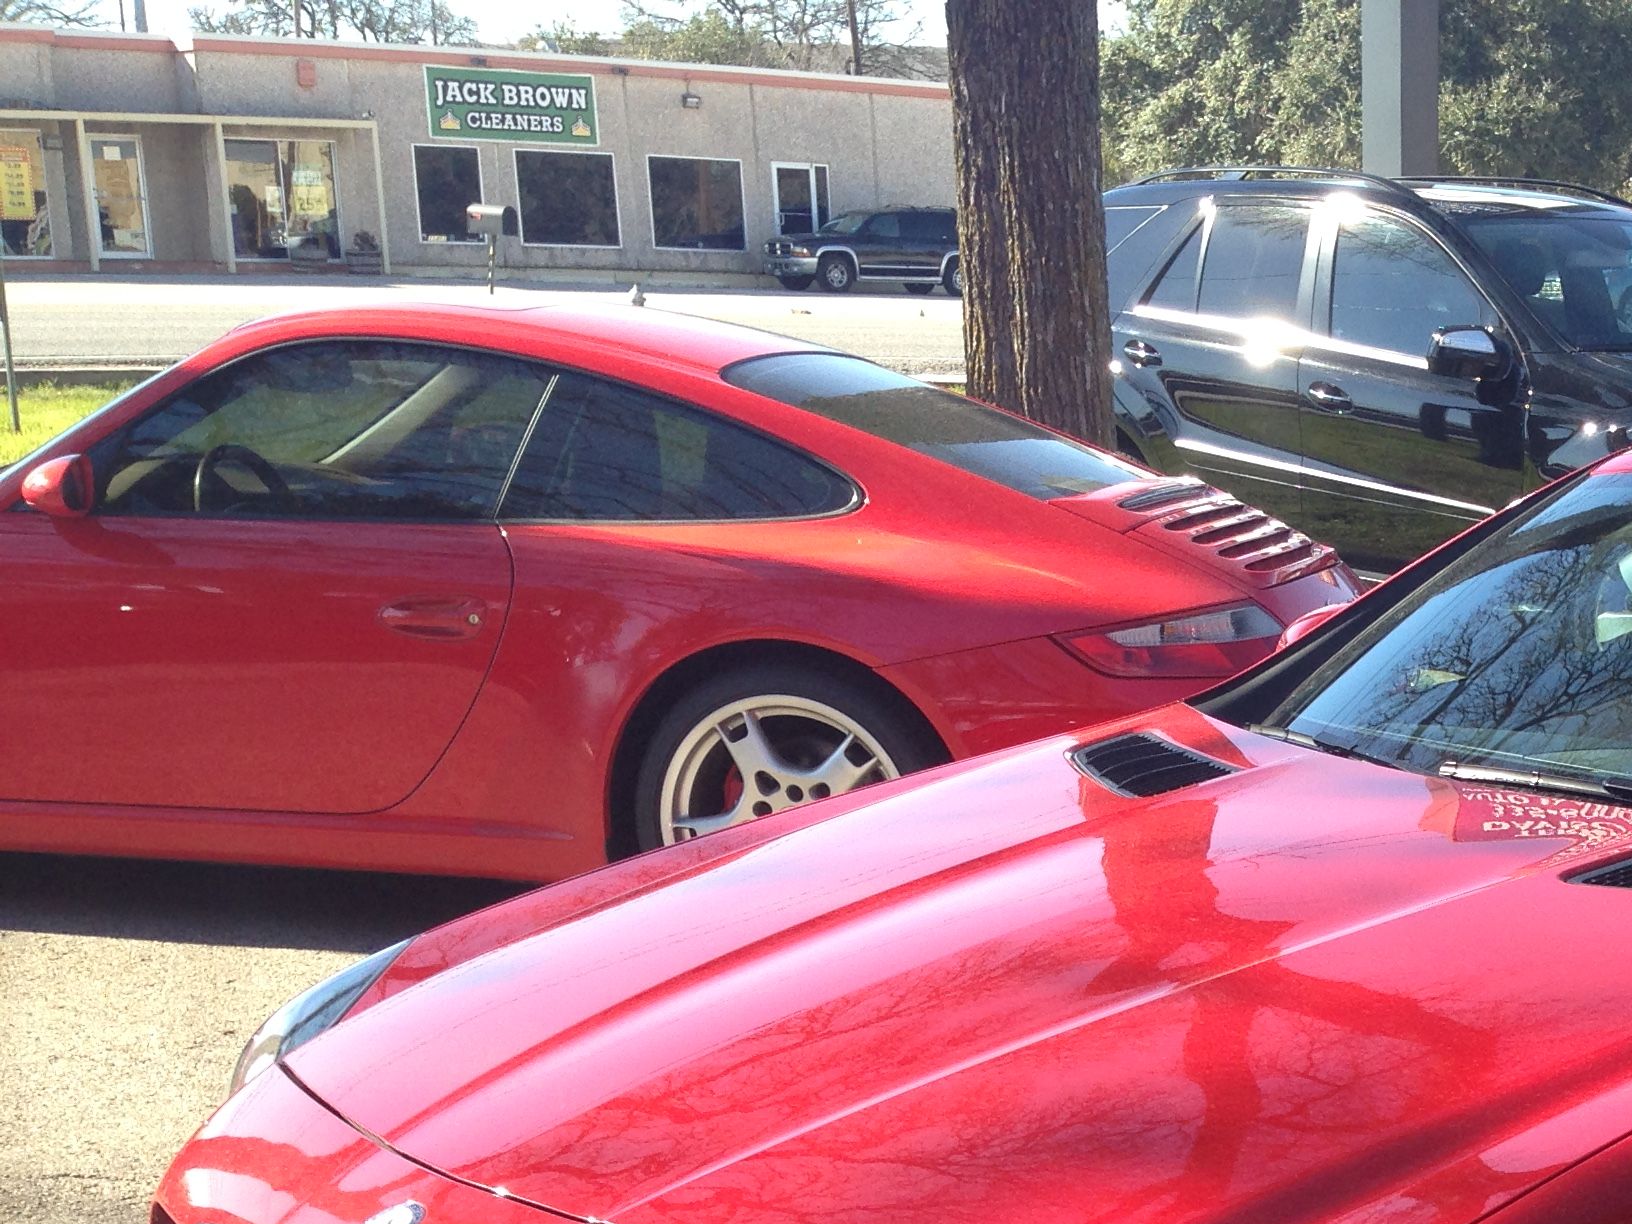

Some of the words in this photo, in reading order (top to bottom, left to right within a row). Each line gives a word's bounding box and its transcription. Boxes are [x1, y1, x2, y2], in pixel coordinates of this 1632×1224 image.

[435, 80, 497, 106] JACK
[502, 84, 587, 109] BROWN
[467, 112, 563, 133] CLEANERS
